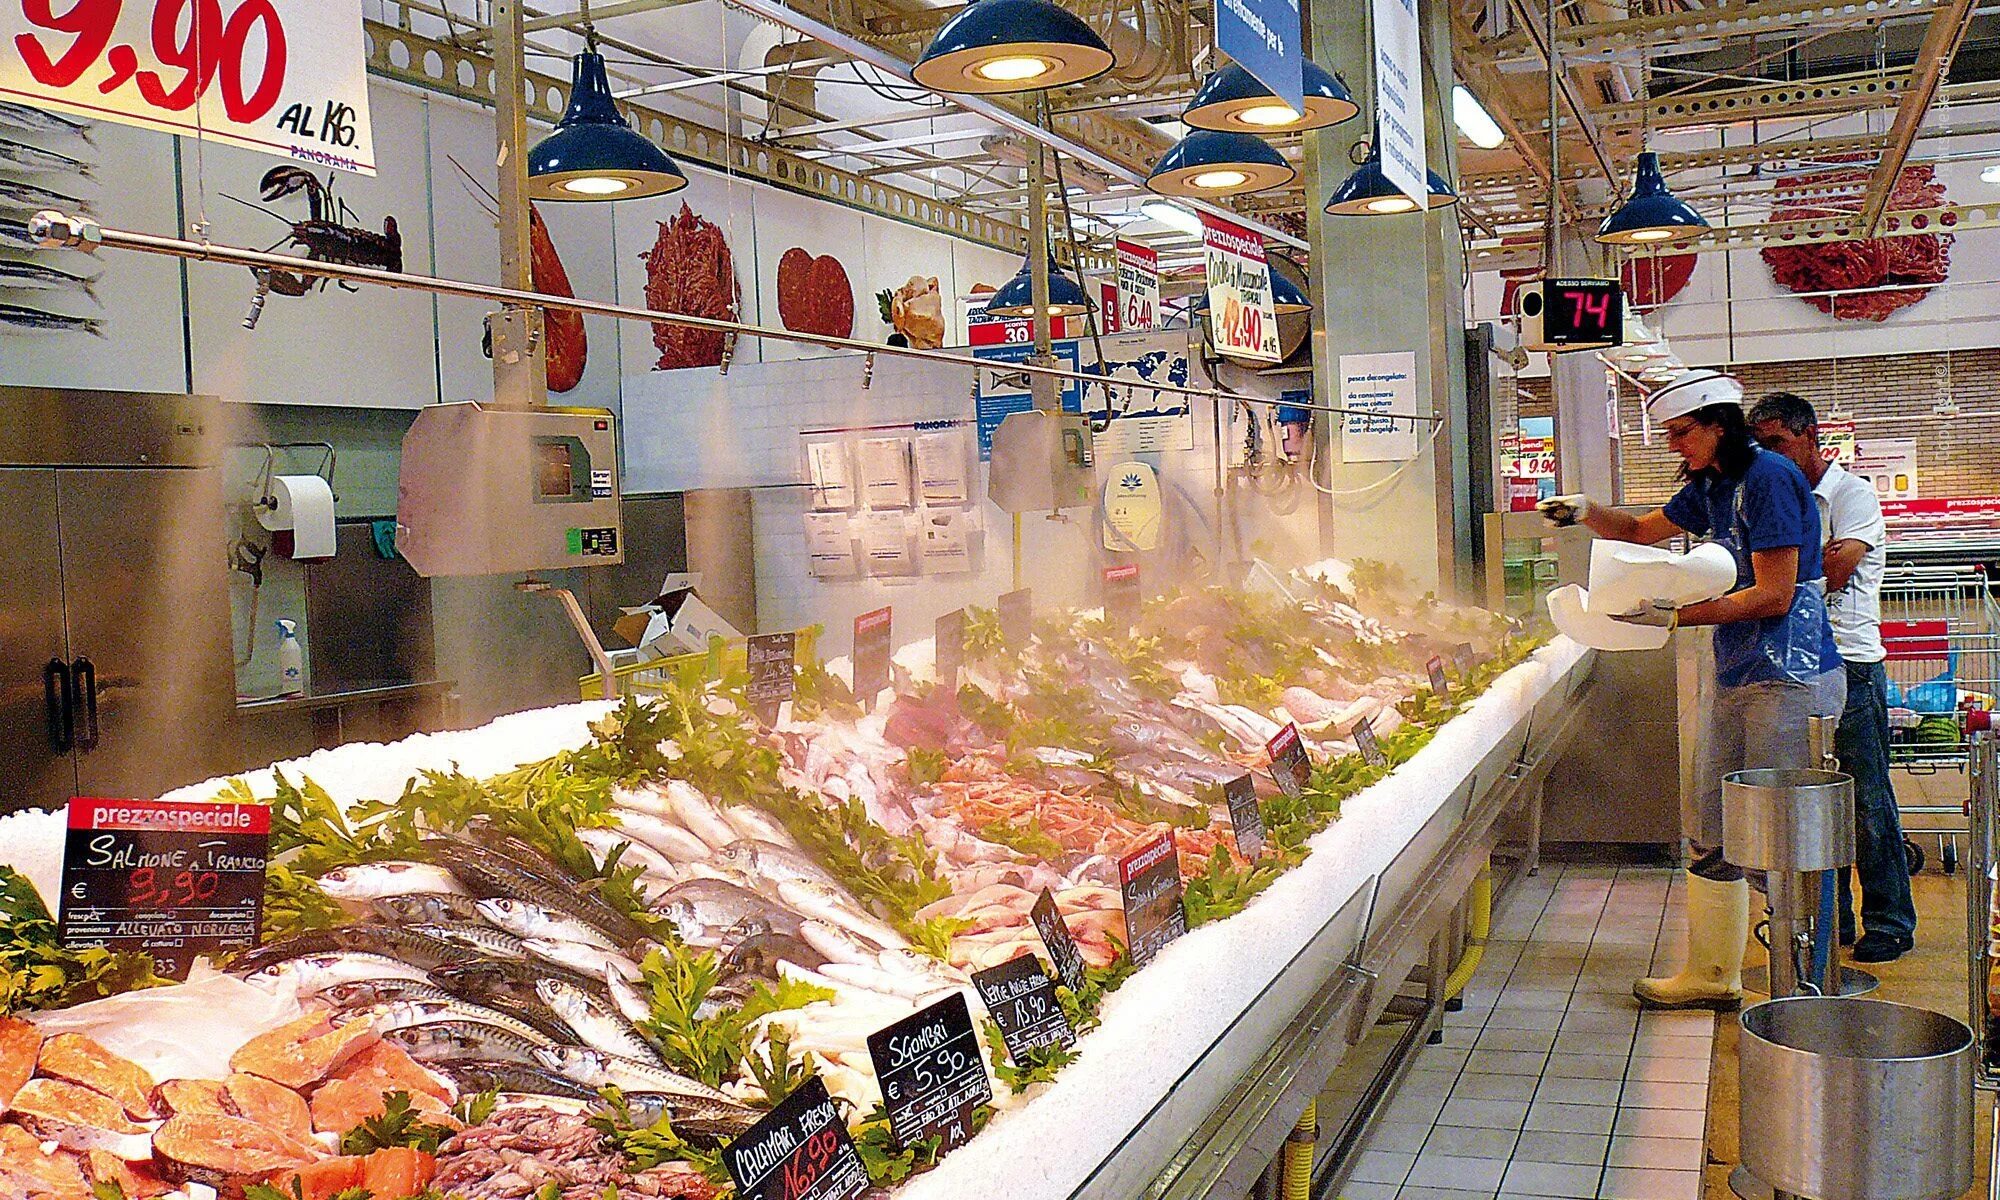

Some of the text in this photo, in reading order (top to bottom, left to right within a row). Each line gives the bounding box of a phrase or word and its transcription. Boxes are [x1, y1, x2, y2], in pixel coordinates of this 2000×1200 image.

[15, 0, 287, 124] 9,90
[277, 100, 359, 149] AL KG.
[290, 145, 358, 171] PANORAMA
[1203, 224, 1265, 259] prezzospeciale
[1208, 251, 1230, 288] Code
[1004, 321, 1028, 329] sconto
[1563, 291, 1610, 330] 74
[1004, 327, 1029, 343] 30
[1215, 313, 1224, 344] €
[1348, 402, 1369, 410] previa
[1358, 391, 1394, 399] consumarsi
[93, 805, 252, 829] prezzospeciale
[87, 835, 187, 869] SALMONE
[1127, 830, 1172, 881] prezzospeciale
[71, 867, 218, 904] € 9,90
[66, 925, 111, 935] provenienza
[115, 920, 183, 937] ALLEVATO
[996, 995, 1047, 1027] € 13,90
[887, 1081, 901, 1100] €
[914, 1049, 966, 1092] 5,90
[783, 1129, 838, 1200] 16,90
